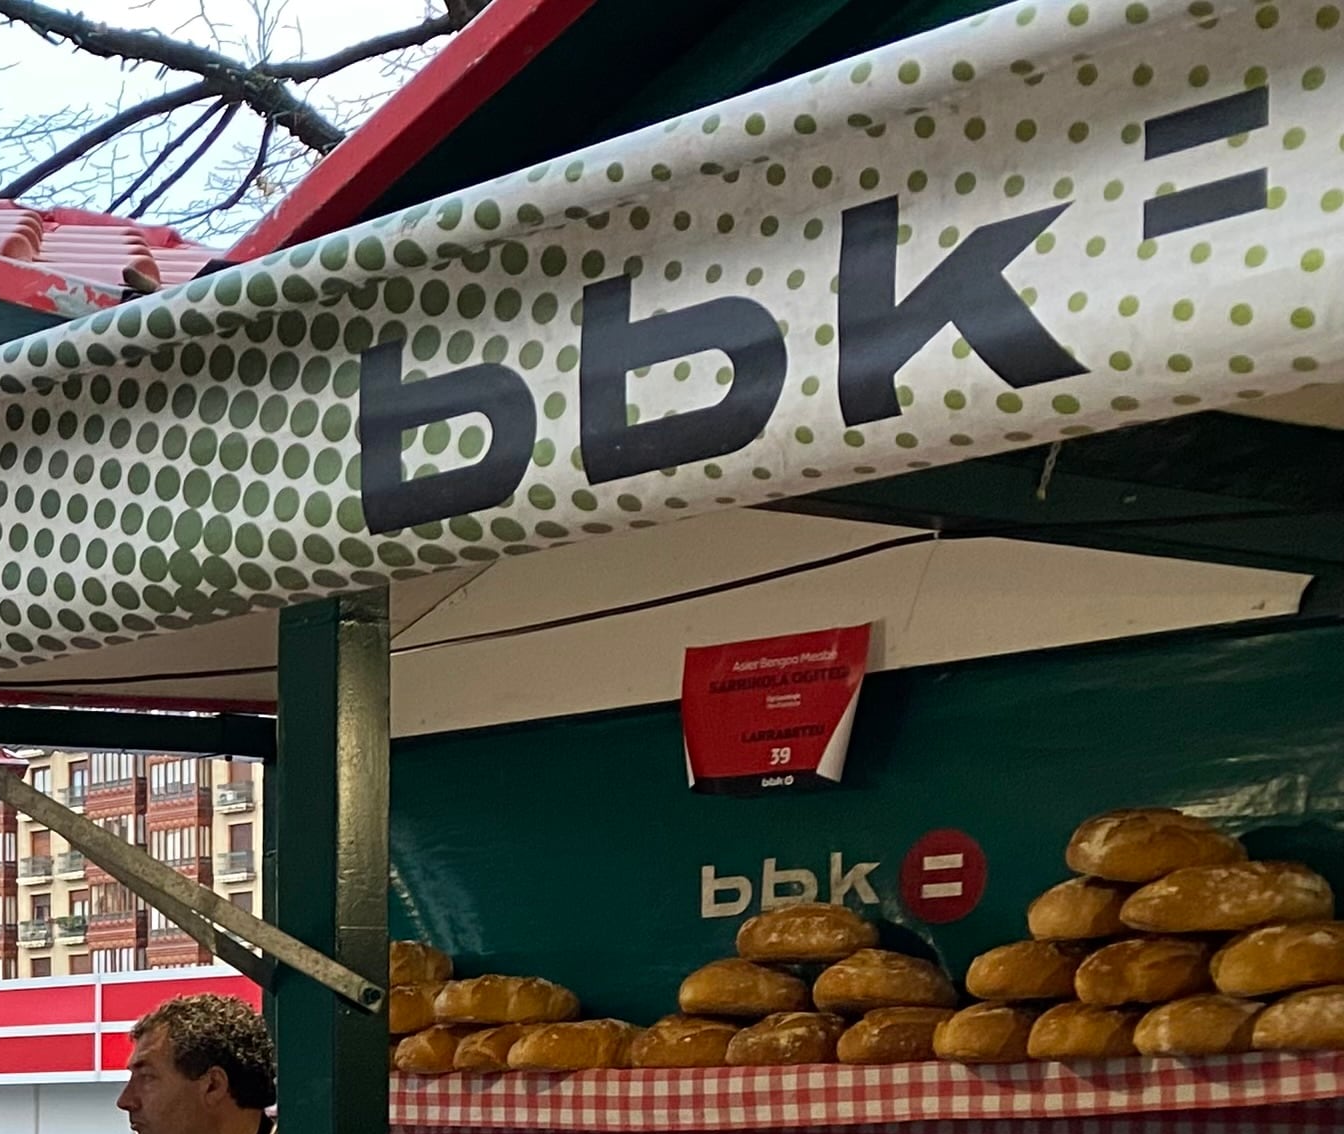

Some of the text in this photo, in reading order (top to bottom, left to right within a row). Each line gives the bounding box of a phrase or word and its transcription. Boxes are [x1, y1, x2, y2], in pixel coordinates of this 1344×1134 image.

[359, 194, 1089, 535] bbk
[769, 747, 791, 765] 39
[701, 852, 880, 919] bbk
